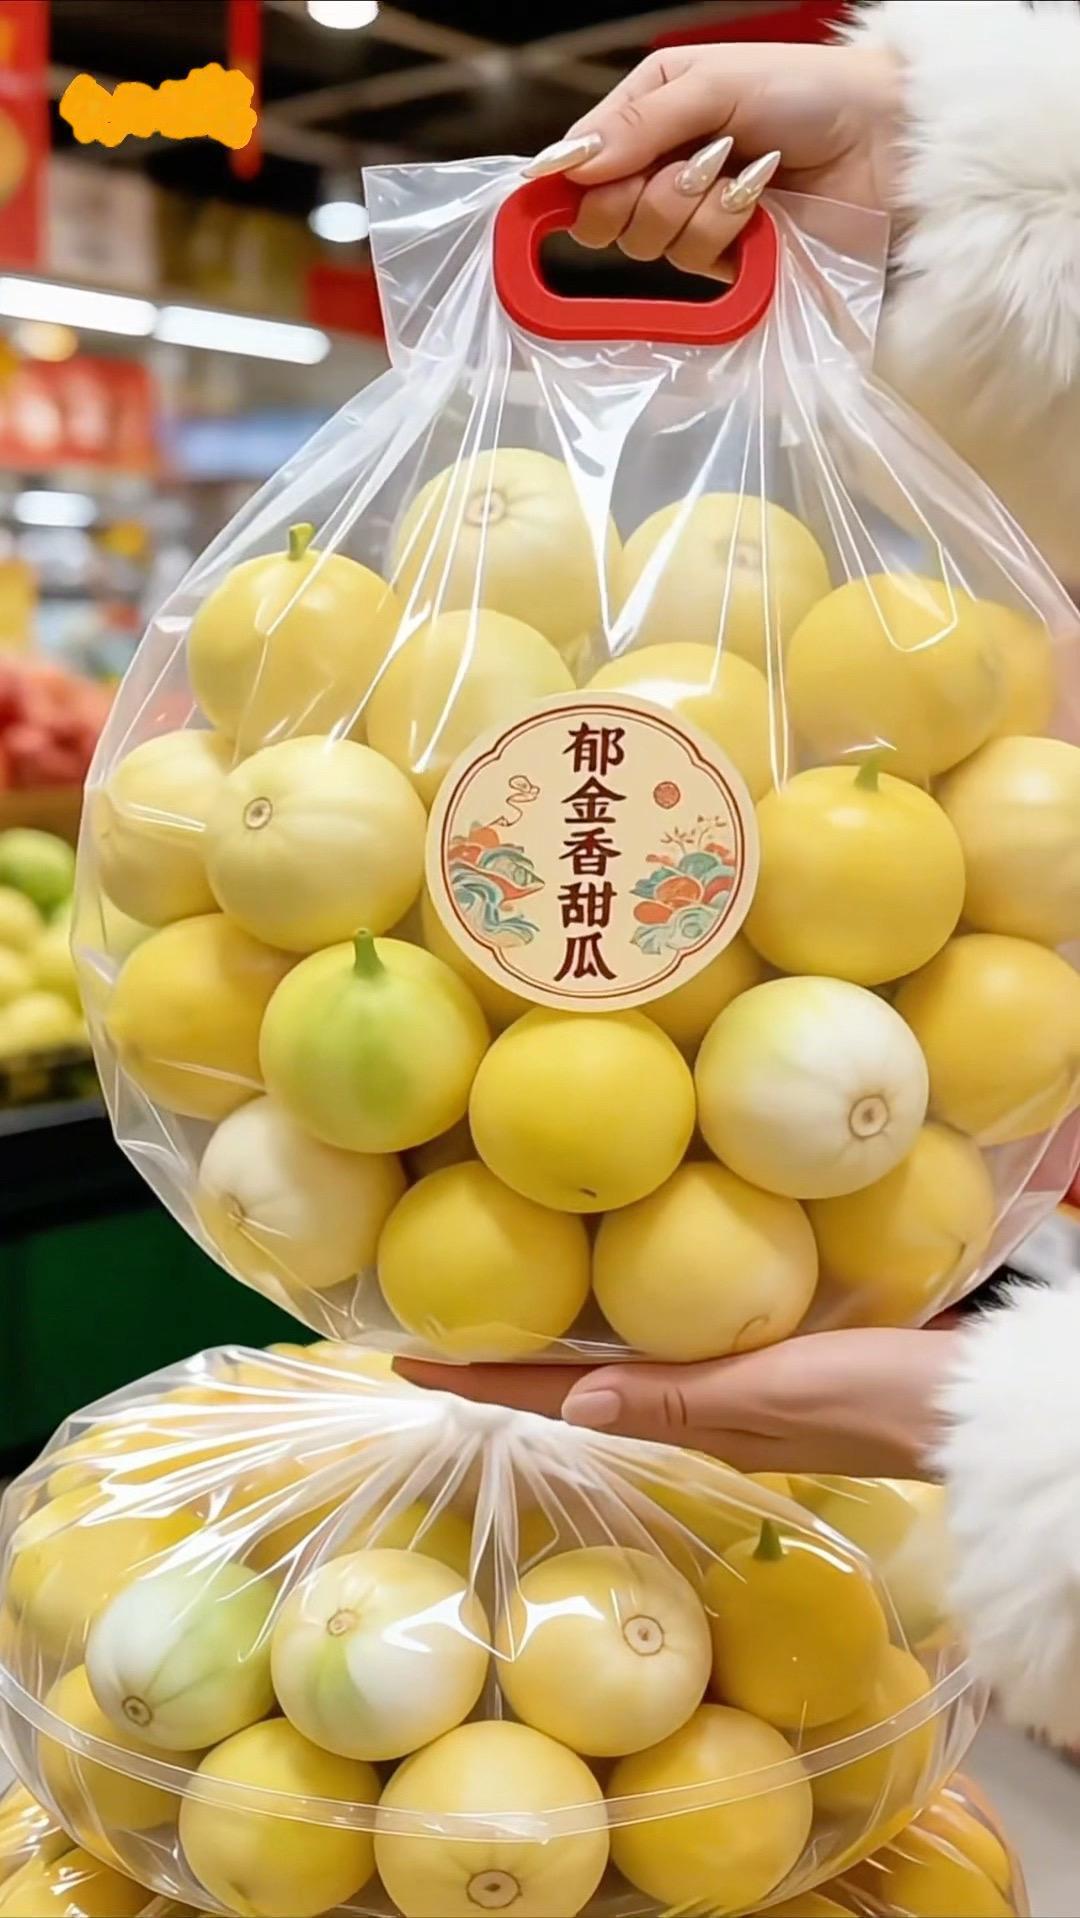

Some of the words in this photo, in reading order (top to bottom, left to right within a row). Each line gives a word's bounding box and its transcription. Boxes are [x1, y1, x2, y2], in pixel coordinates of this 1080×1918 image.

[553, 721, 627, 982] 郁金香甜瓜
